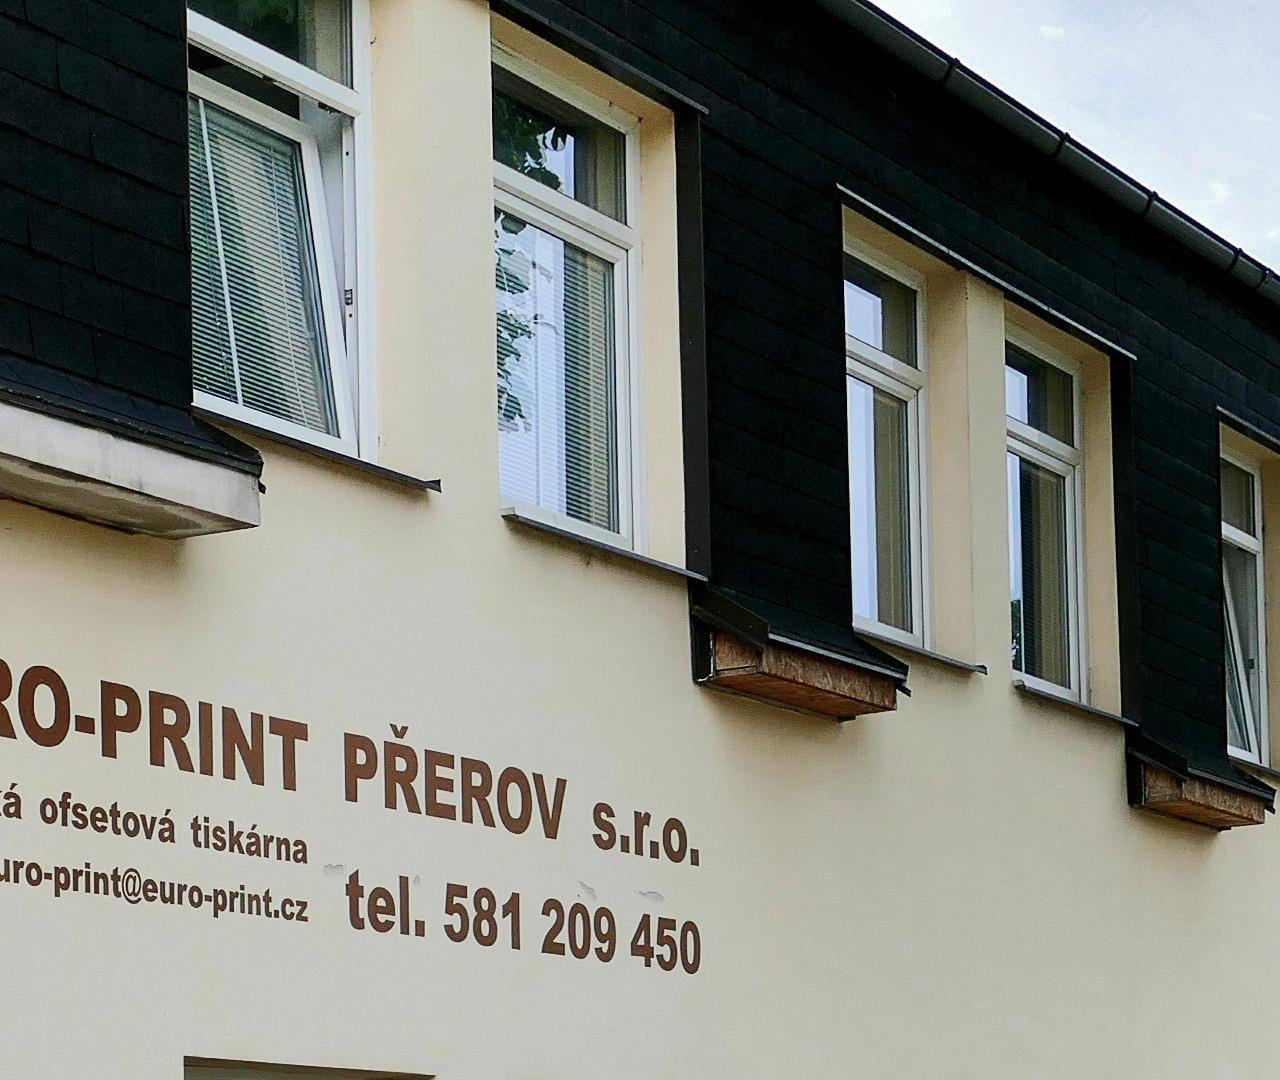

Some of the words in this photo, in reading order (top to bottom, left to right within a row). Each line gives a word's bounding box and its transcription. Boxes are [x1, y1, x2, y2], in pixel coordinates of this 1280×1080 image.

[39, 791, 176, 844] ofsetová
[190, 815, 308, 865] tiskárna
[343, 724, 568, 840] PŘEROV
[592, 803, 700, 867] s.r.o.
[345, 868, 426, 938] tel.
[443, 882, 521, 951] 581
[540, 898, 617, 963] 209
[630, 913, 701, 975] 450
